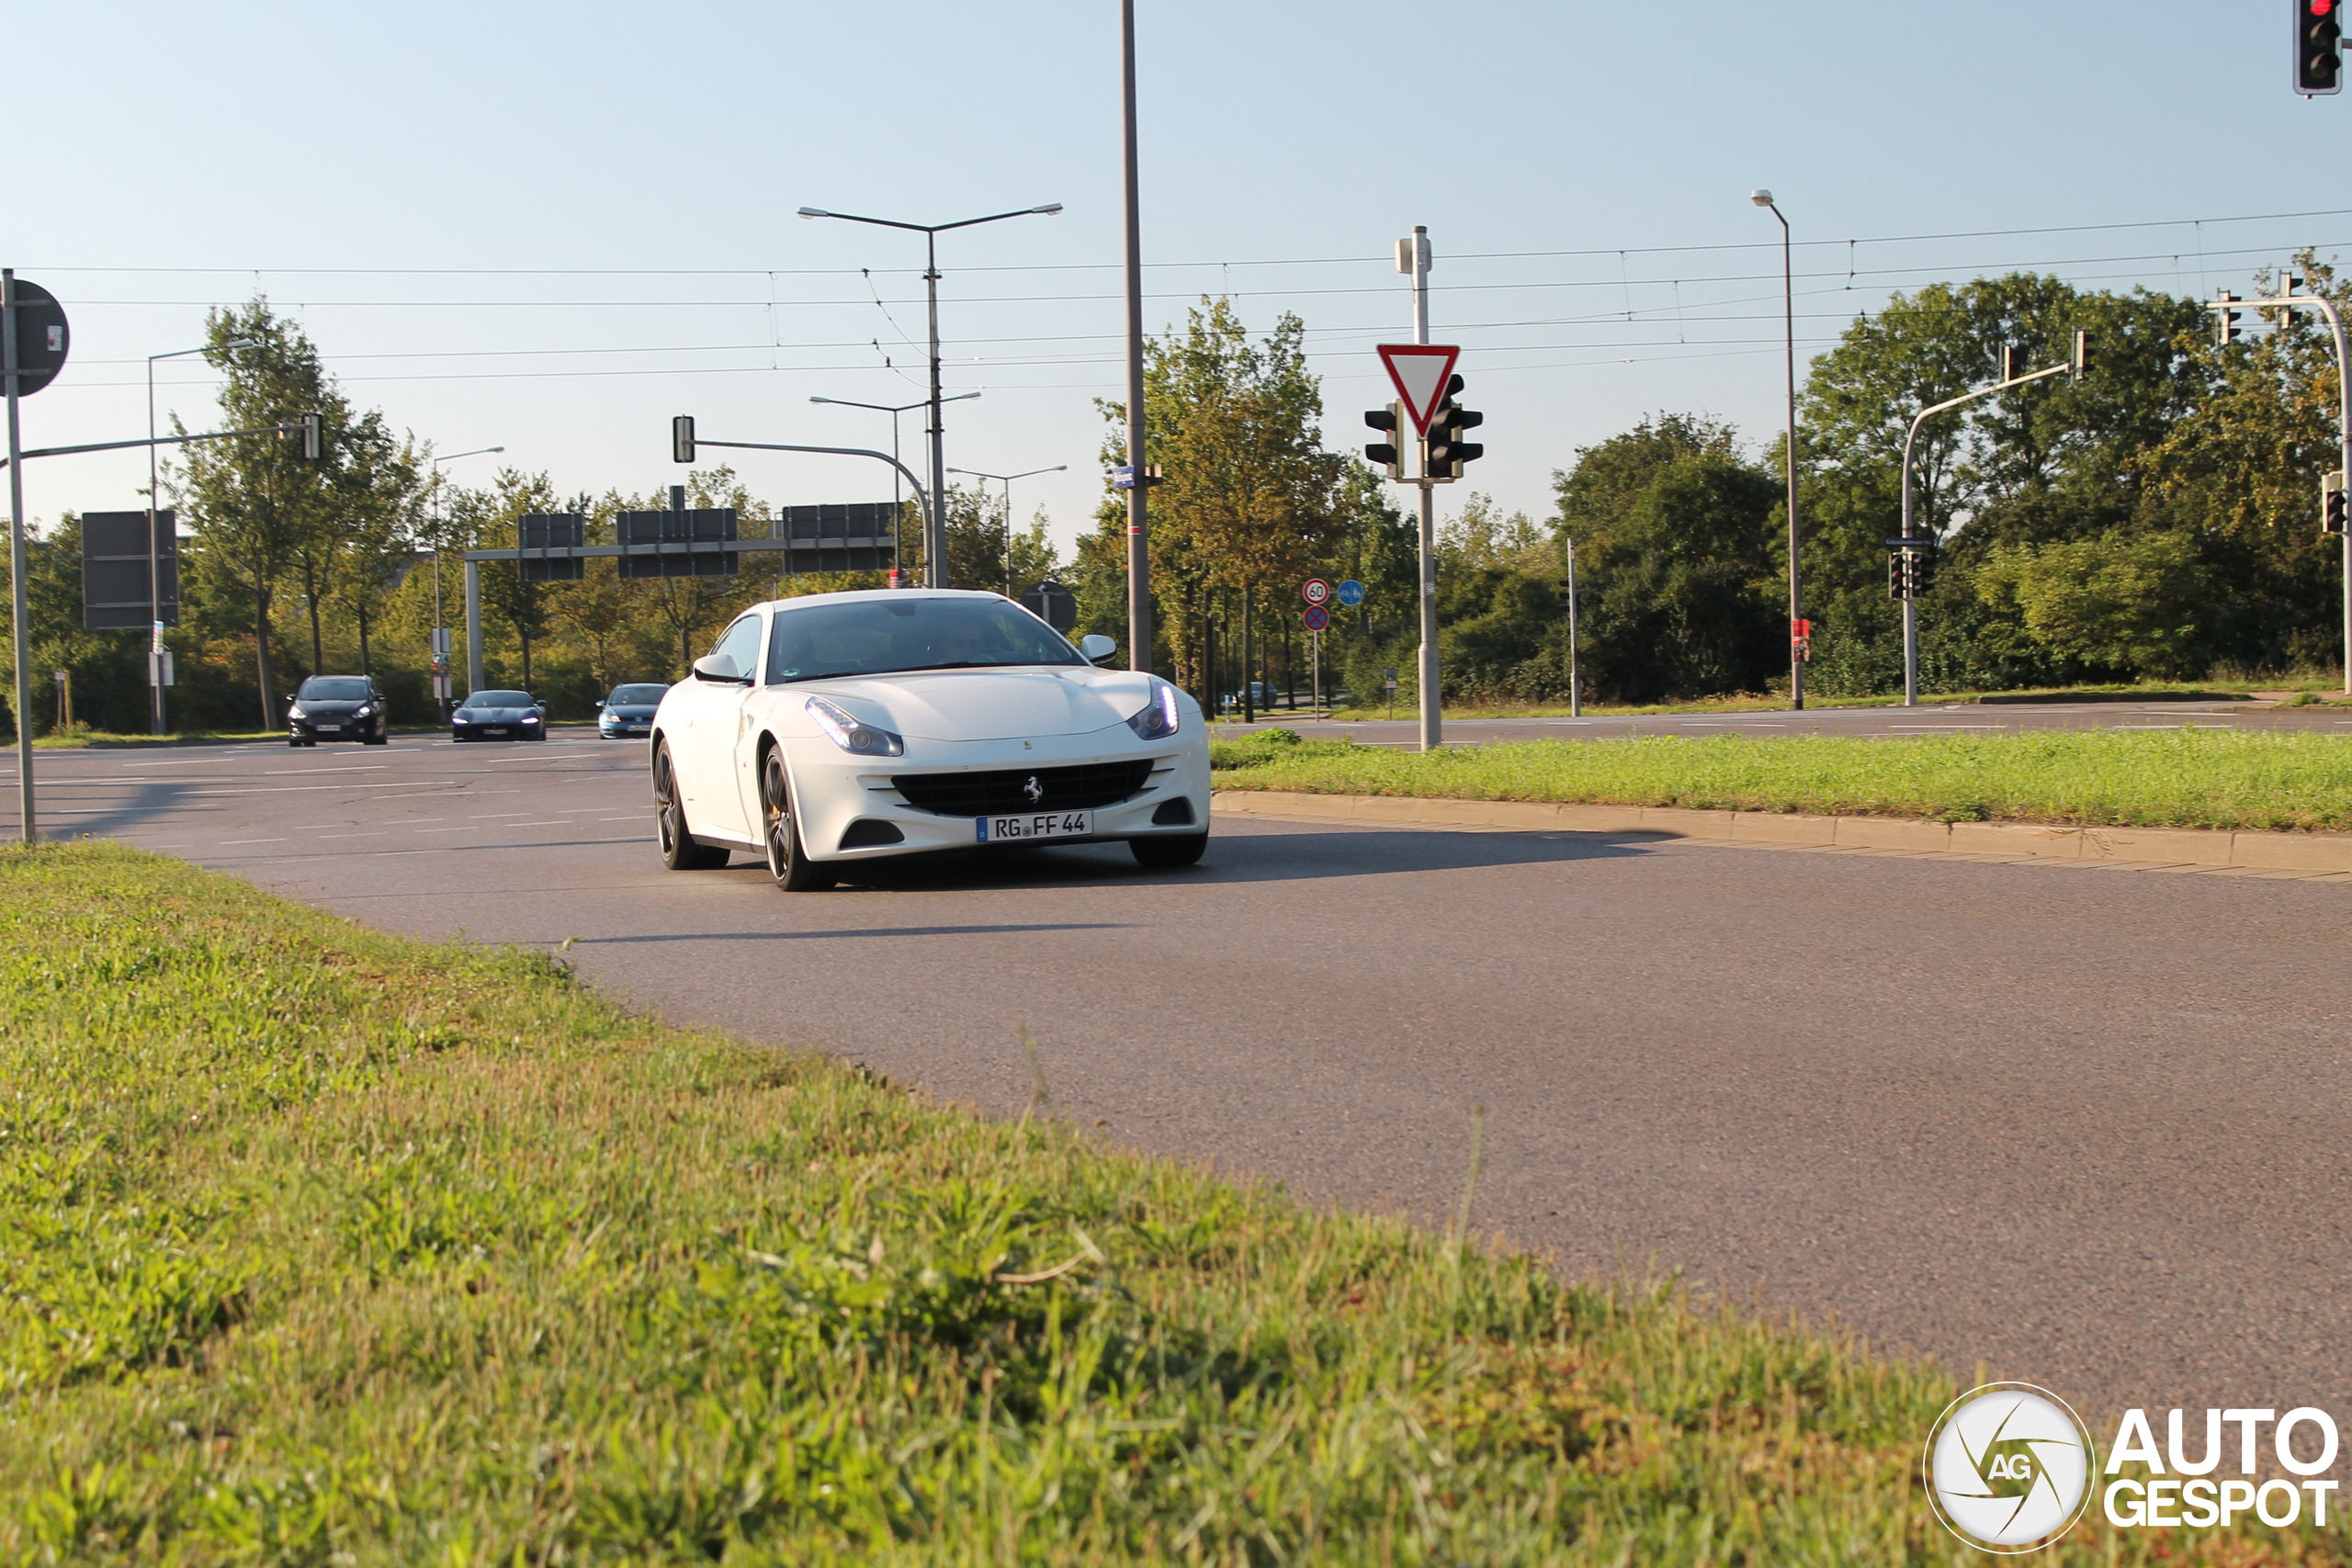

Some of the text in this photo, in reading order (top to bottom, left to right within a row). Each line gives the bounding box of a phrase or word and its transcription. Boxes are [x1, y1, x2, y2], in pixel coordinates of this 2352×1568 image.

[1309, 586, 1324, 597] 60
[996, 813, 1085, 838] RG FF 44
